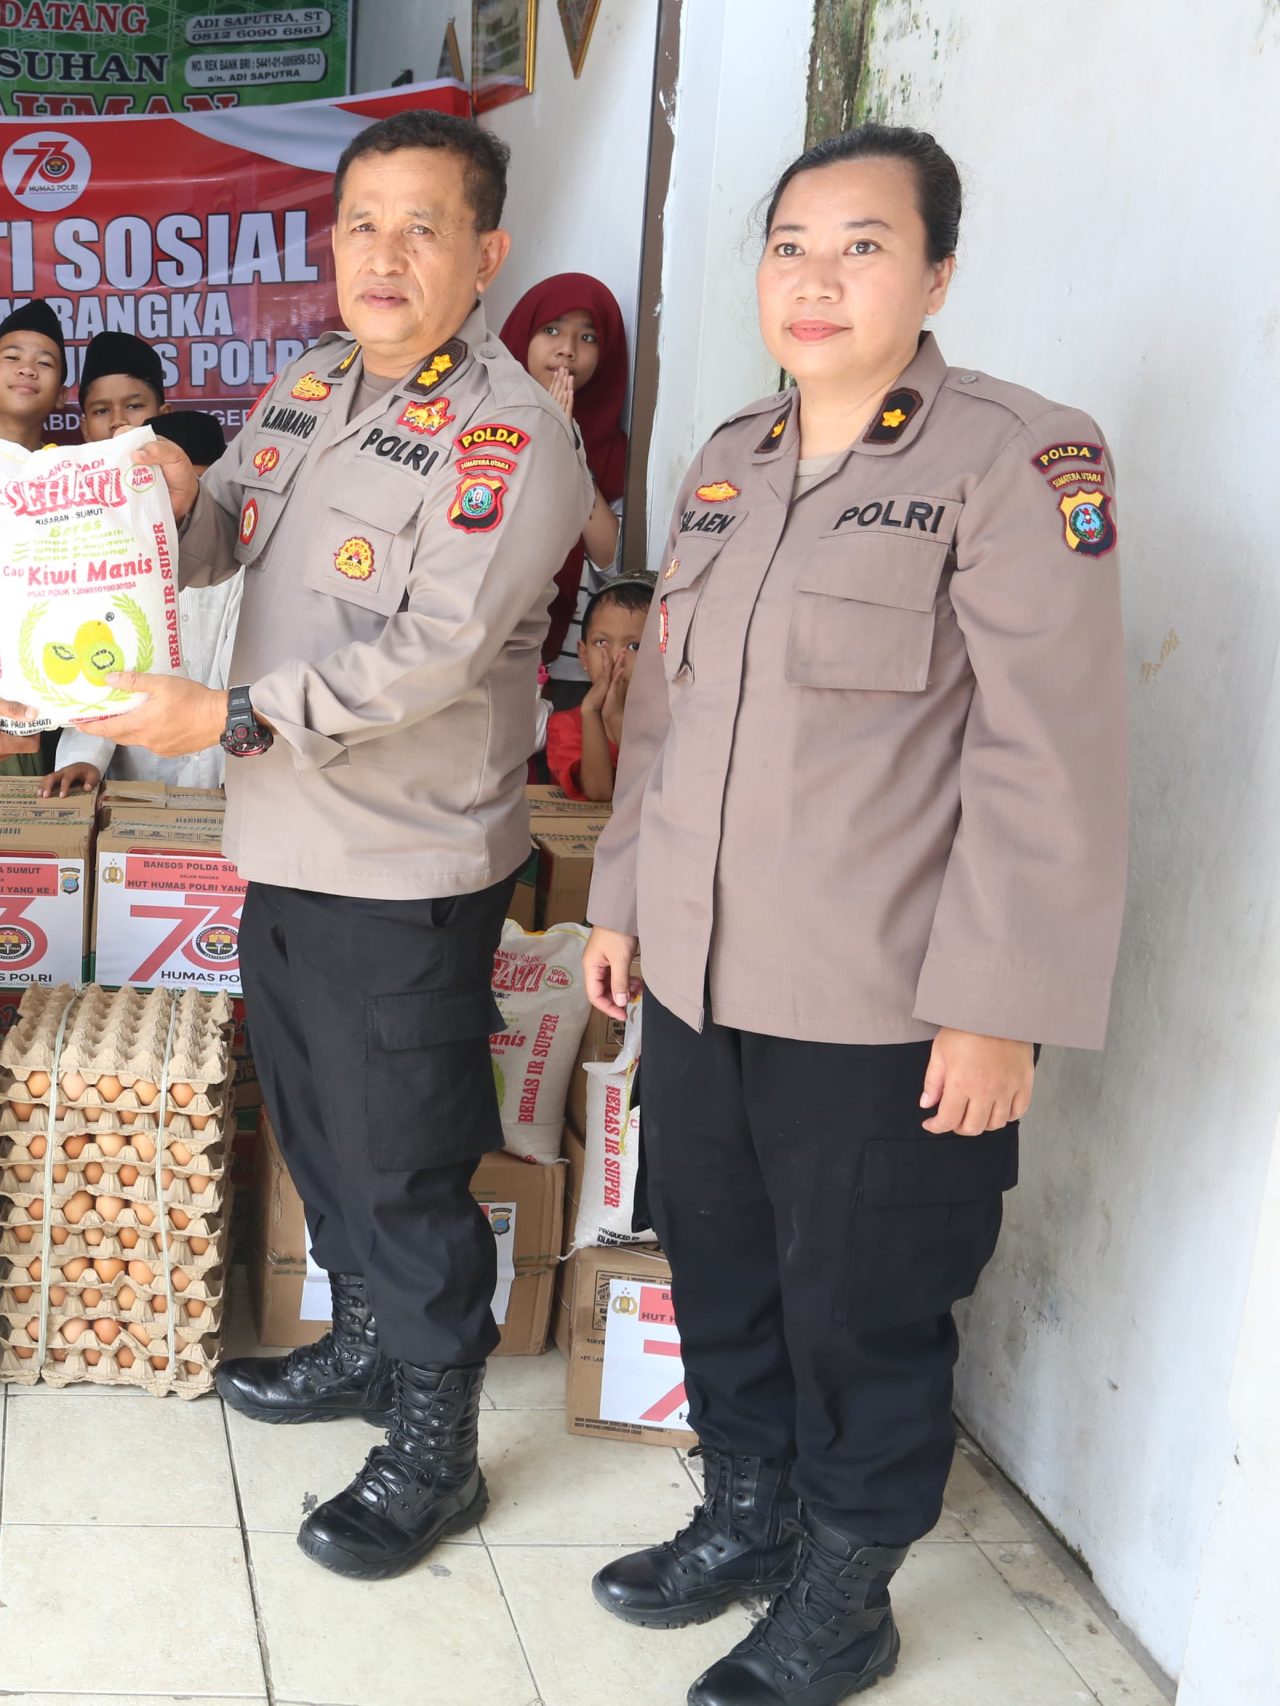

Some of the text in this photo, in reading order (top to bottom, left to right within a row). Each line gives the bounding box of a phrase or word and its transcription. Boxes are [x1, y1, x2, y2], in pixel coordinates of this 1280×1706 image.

[193, 19, 220, 29] ADI
[303, 11, 323, 22] ST
[192, 25, 323, 42] 0812 6090 6861
[219, 58, 239, 71] BANK
[228, 73, 248, 82] ADI
[250, 69, 300, 81] SAPUTRA
[12, 141, 76, 196] 73
[54, 211, 318, 291] SOSIAL
[45, 291, 234, 340] RANGKA
[191, 338, 320, 386] POL
[461, 427, 520, 448] POLDA
[360, 428, 440, 477] POLRI
[1040, 446, 1092, 466] POLDA
[460, 459, 509, 471] SUMATERA UTARA
[1052, 471, 1101, 488] SUMATERA UTARA
[832, 500, 945, 534] POLRI
[27, 563, 77, 586] Kiwi
[87, 552, 153, 582] Manis
[152, 521, 181, 670] BERAS IR SUPER
[7, 867, 41, 875] SUMUT
[143, 860, 184, 870] BANSOS
[186, 862, 219, 872] POLDA
[127, 880, 248, 893] HUT HUMAS POLRI YANG
[128, 893, 246, 982] 73
[9, 973, 52, 983] POLRI
[161, 970, 215, 982] HUMAS
[489, 1030, 527, 1048] anis
[518, 1013, 560, 1123] BERAS IR SUPER
[604, 1084, 621, 1210] BERAS IR SUPER
[598, 1226, 631, 1241] PRODUCED
[641, 1312, 666, 1322] HUT
